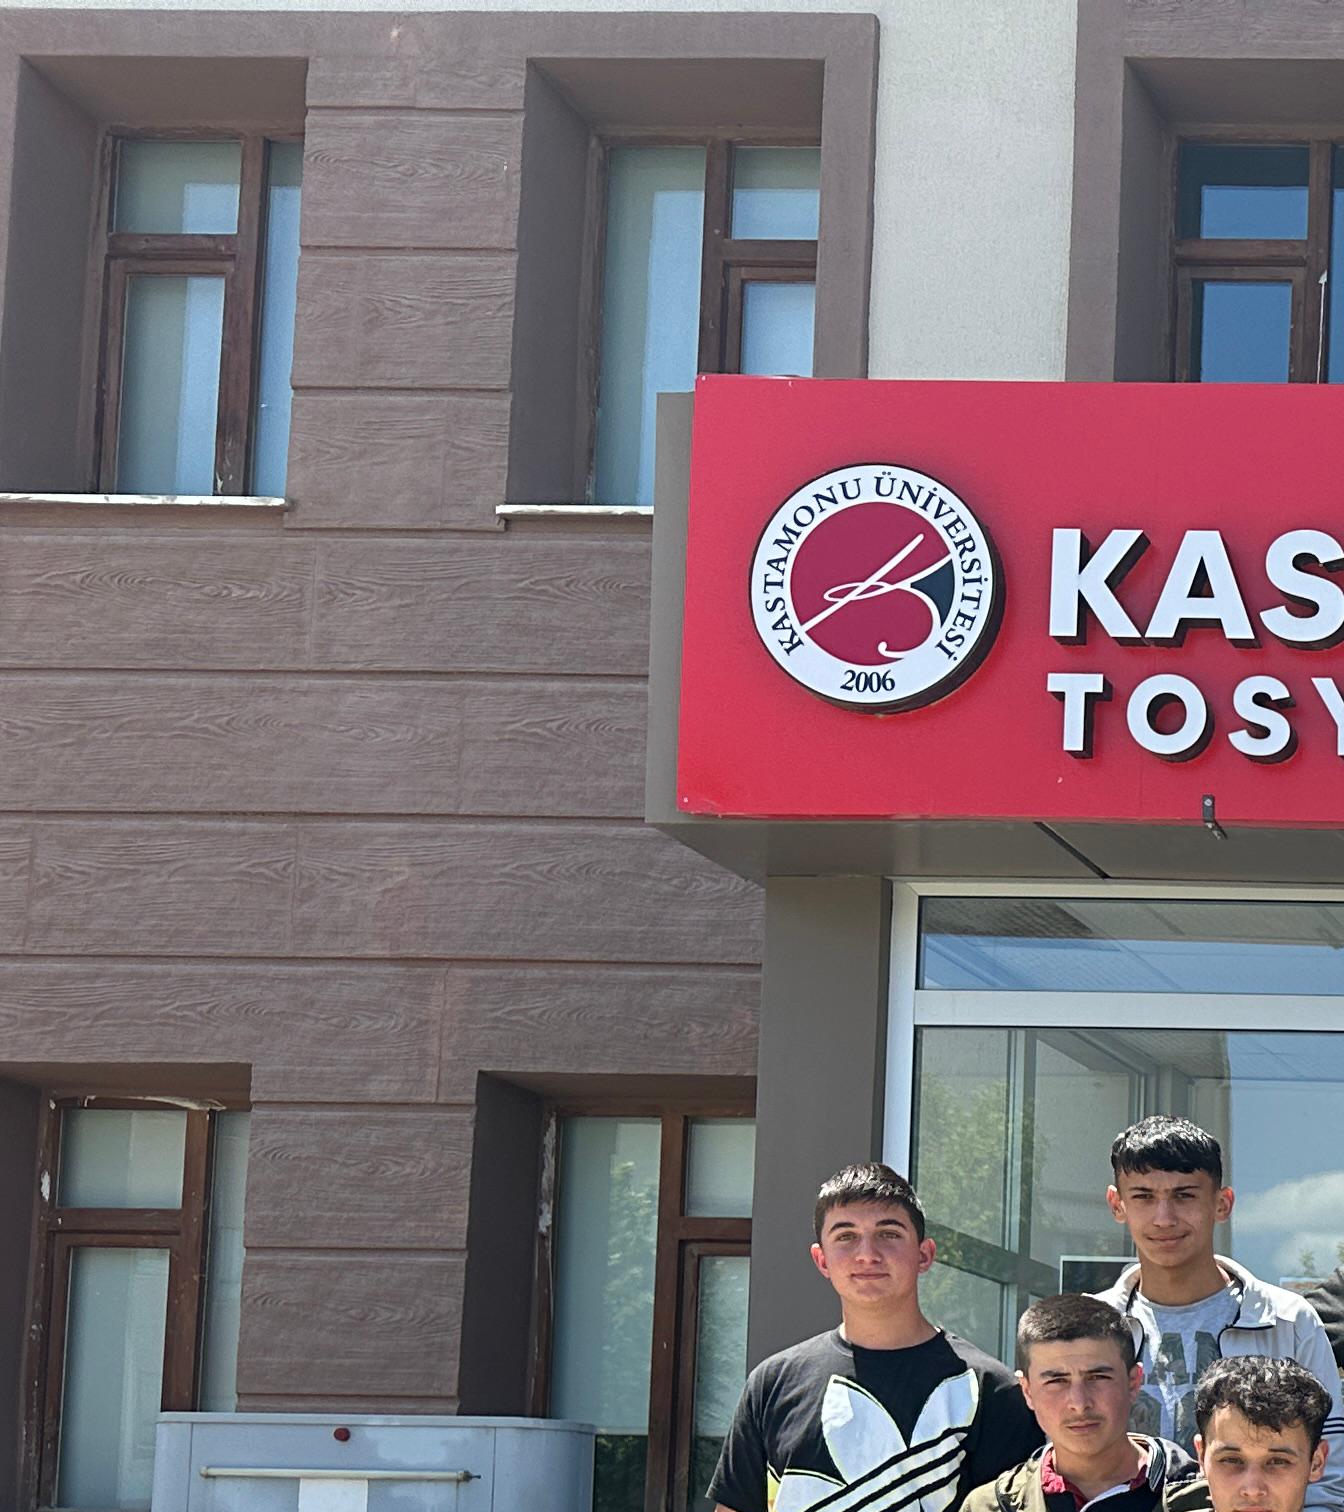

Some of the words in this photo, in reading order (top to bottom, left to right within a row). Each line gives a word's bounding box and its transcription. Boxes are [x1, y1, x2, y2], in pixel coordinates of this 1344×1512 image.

[763, 477, 862, 656] KASTAMONU
[873, 471, 989, 661] ÜNİVERSİTESİ
[840, 669, 896, 693] 2006
